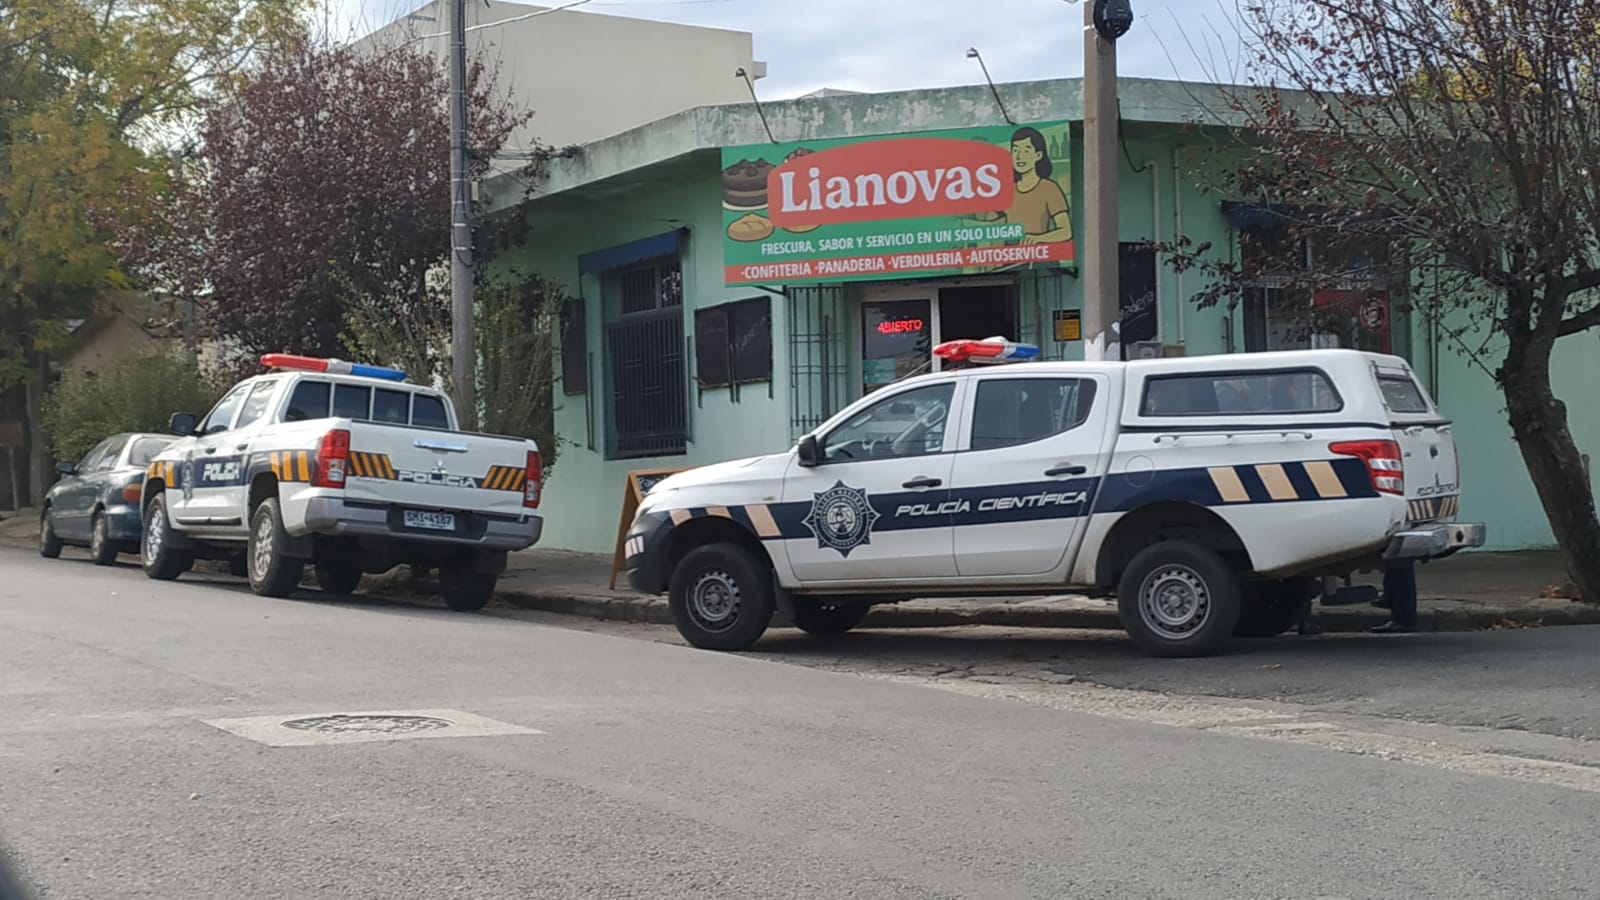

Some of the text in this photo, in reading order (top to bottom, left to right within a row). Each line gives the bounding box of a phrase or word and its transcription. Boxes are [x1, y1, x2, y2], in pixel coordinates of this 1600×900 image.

[780, 164, 1001, 212] Lianovas
[761, 225, 1022, 255] FRESCURA, SABOR Y SERVICIO EN UN SOLO LUGAR
[877, 320, 923, 334] ABIERTO
[895, 491, 1087, 517] POLICÍA CIENTÍFICA
